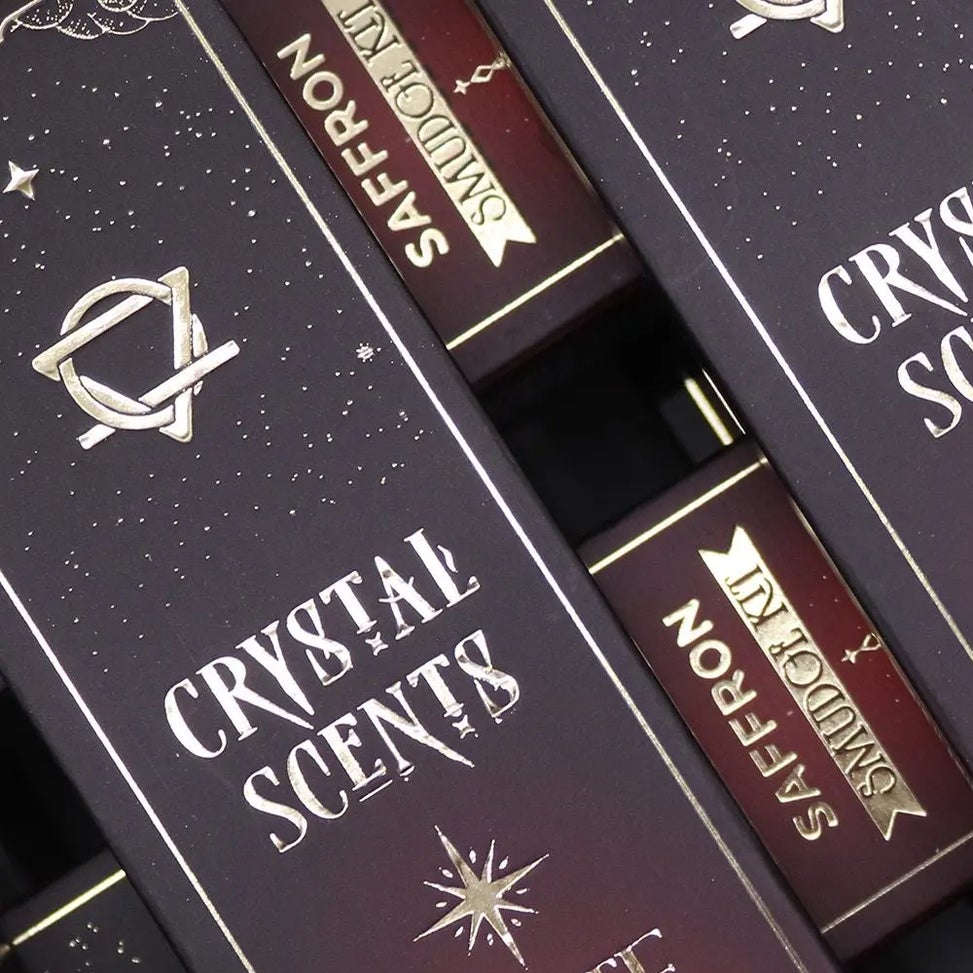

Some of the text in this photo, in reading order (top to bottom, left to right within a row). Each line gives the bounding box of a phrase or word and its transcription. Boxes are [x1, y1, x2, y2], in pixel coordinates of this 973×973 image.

[276, 33, 449, 268] SAFFRON
[337, 0, 507, 226] SMUDGE KIT
[164, 528, 480, 759] CRYSTAL
[243, 630, 520, 853] SCENTS
[662, 598, 838, 841] SAFFRON
[724, 563, 897, 798] SMUDGE KIT
